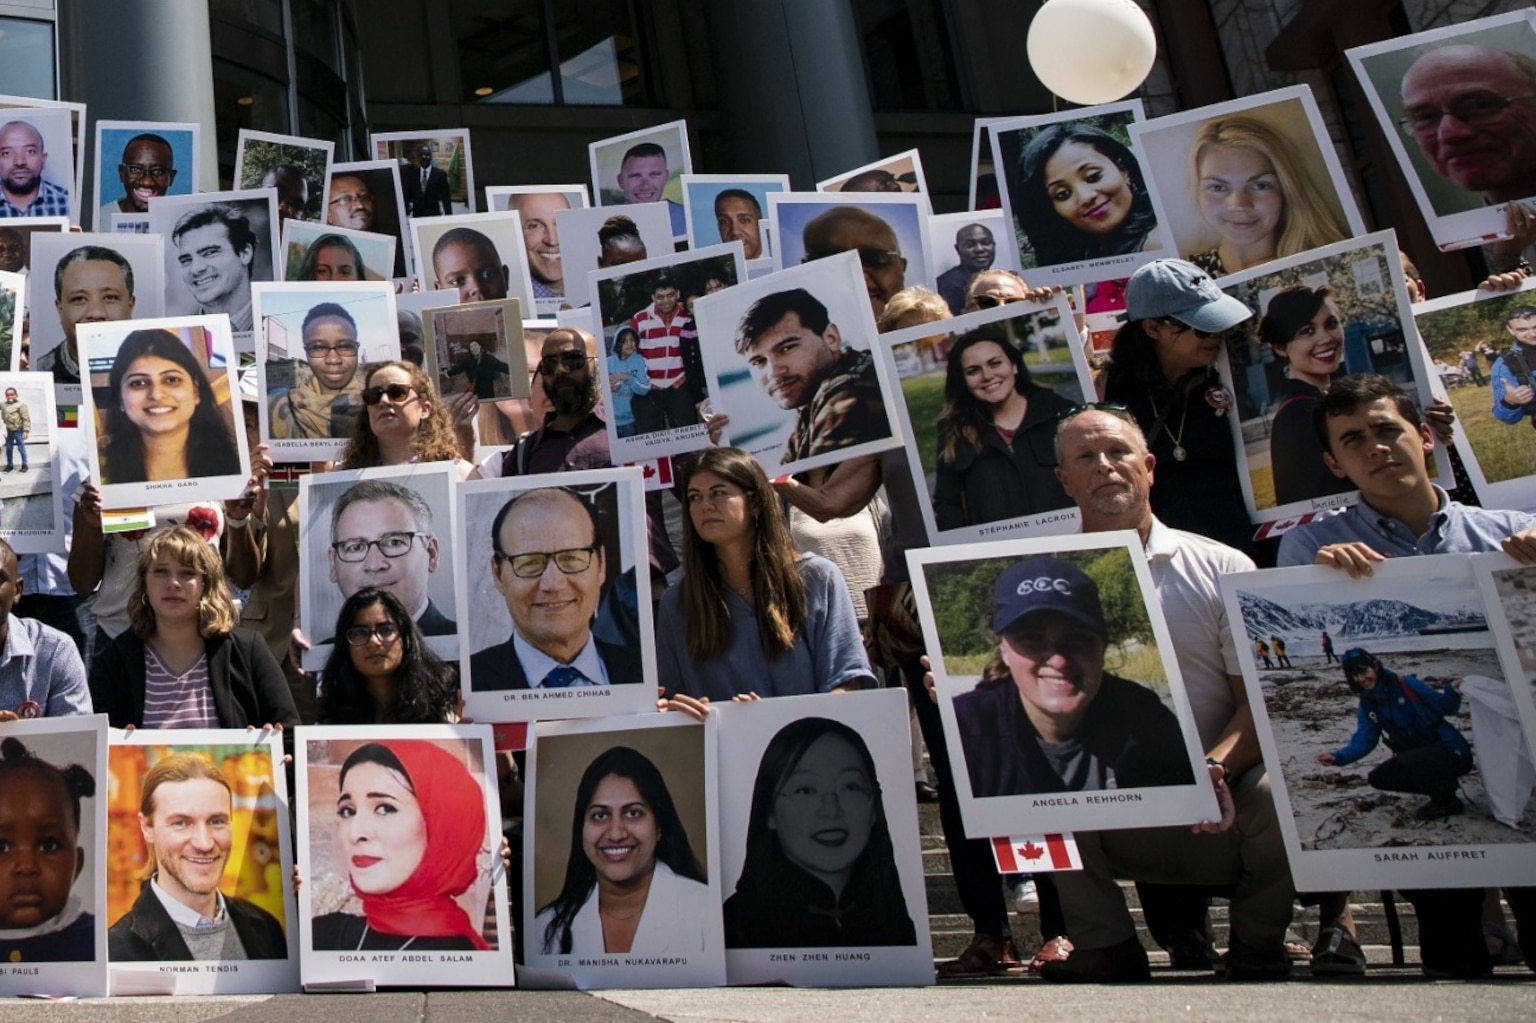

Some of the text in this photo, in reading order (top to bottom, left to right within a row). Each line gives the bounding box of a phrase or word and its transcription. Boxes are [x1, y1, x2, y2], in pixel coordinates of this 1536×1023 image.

[1310, 495, 1350, 511] Danielle
[978, 512, 1077, 536] STÉPHANIE LACROIX
[542, 691, 574, 699] AHMED
[576, 689, 611, 698] CHIHAB
[1032, 793, 1143, 807] ANGELA REHHORN
[1374, 850, 1486, 862] SARAH AUFFRET
[557, 959, 573, 967] DR.
[625, 957, 688, 966] NUKAVARAPU
[770, 952, 871, 962] ZHEN ZHEN HUANG
[12, 967, 39, 975] PAULS
[159, 965, 200, 973] NORMAN
